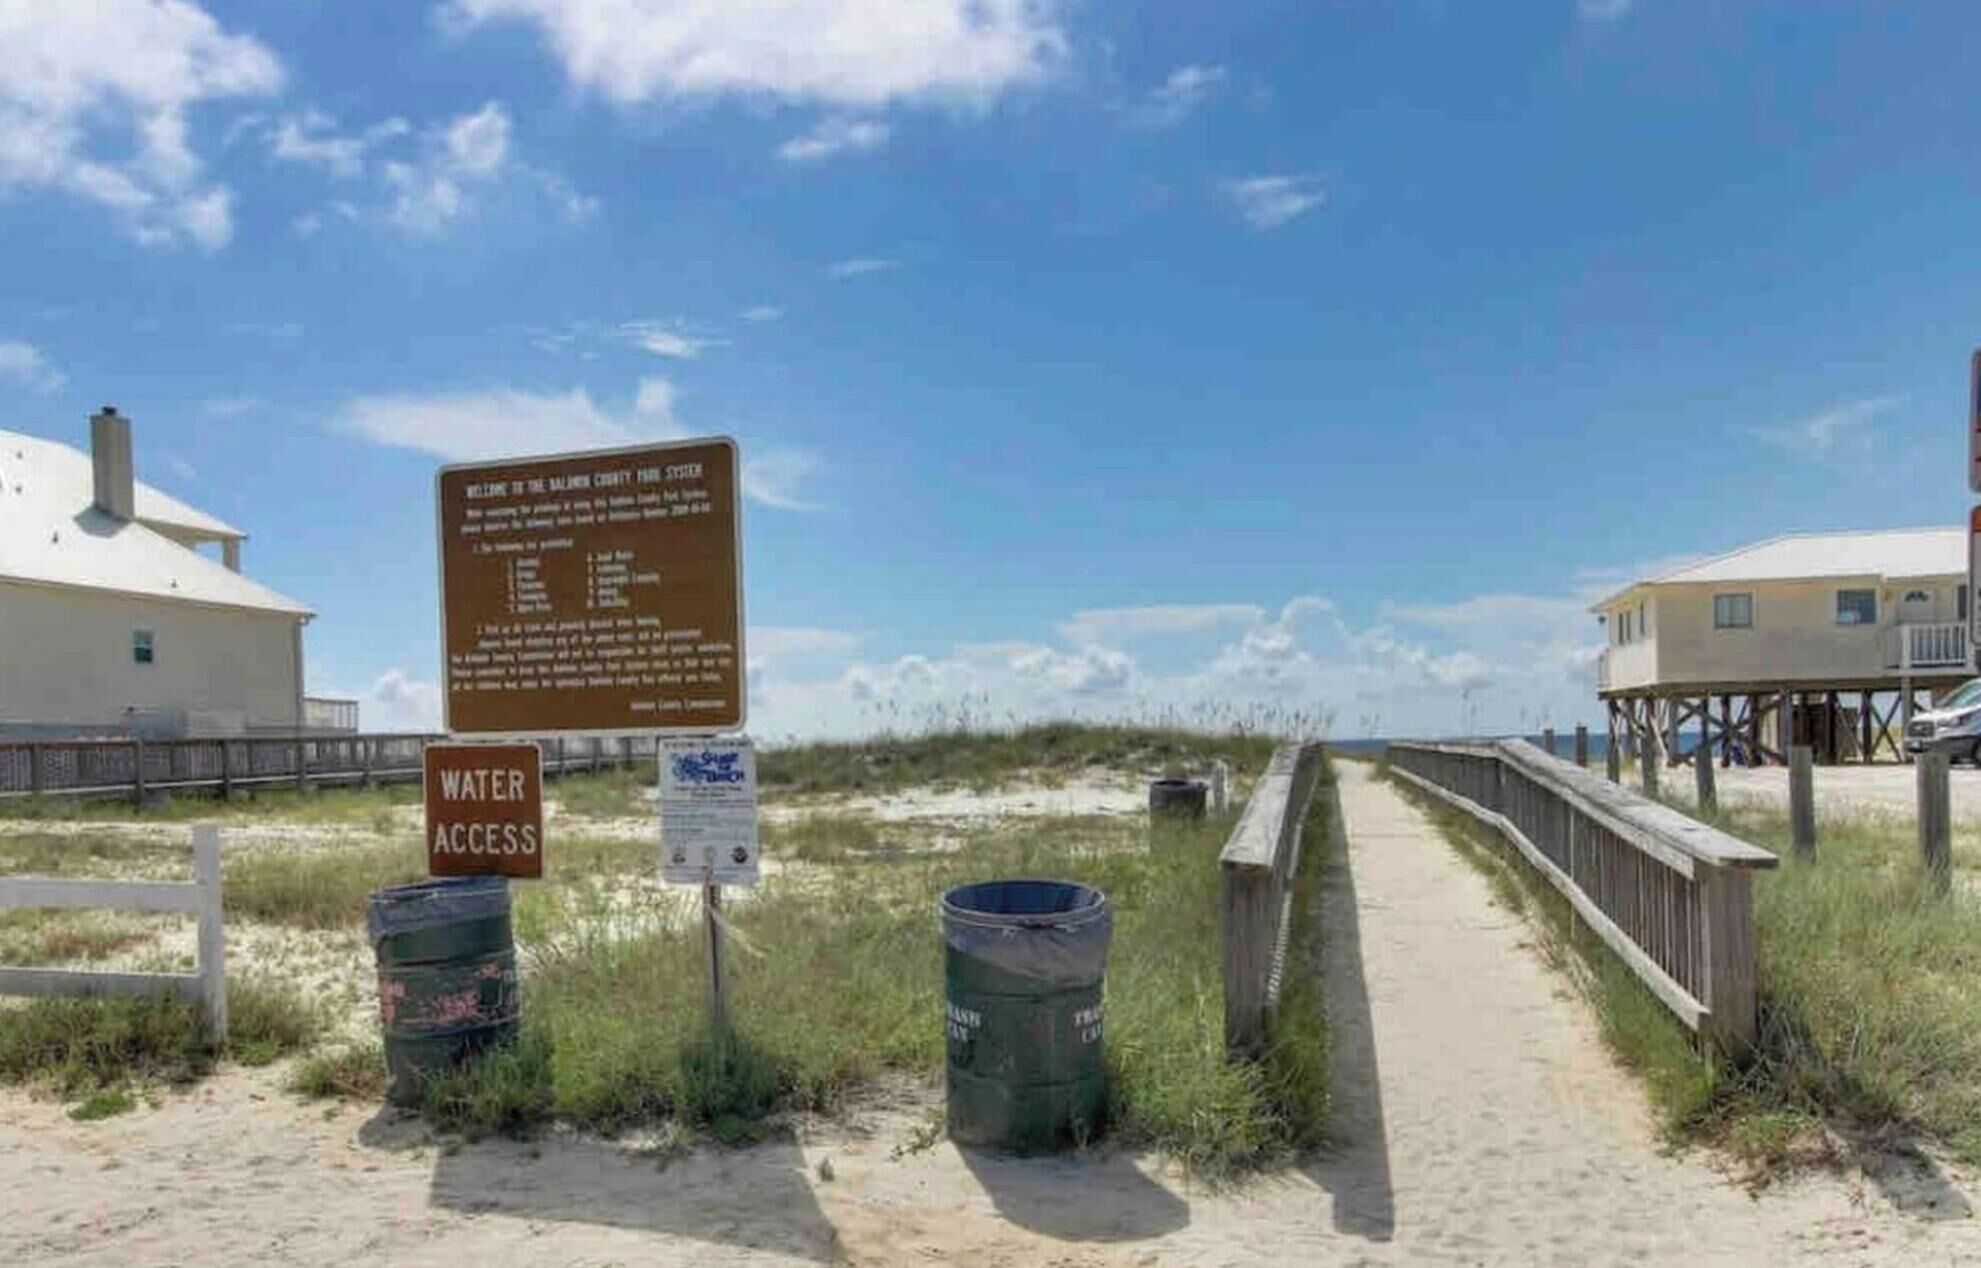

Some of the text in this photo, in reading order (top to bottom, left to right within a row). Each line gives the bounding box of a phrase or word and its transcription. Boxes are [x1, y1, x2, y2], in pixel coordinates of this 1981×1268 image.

[512, 479, 524, 494] TO
[528, 477, 545, 493] THE
[594, 470, 632, 488] COUNTY
[637, 467, 661, 482] PARK
[440, 768, 525, 801] WATER
[433, 822, 537, 855] ACCESS
